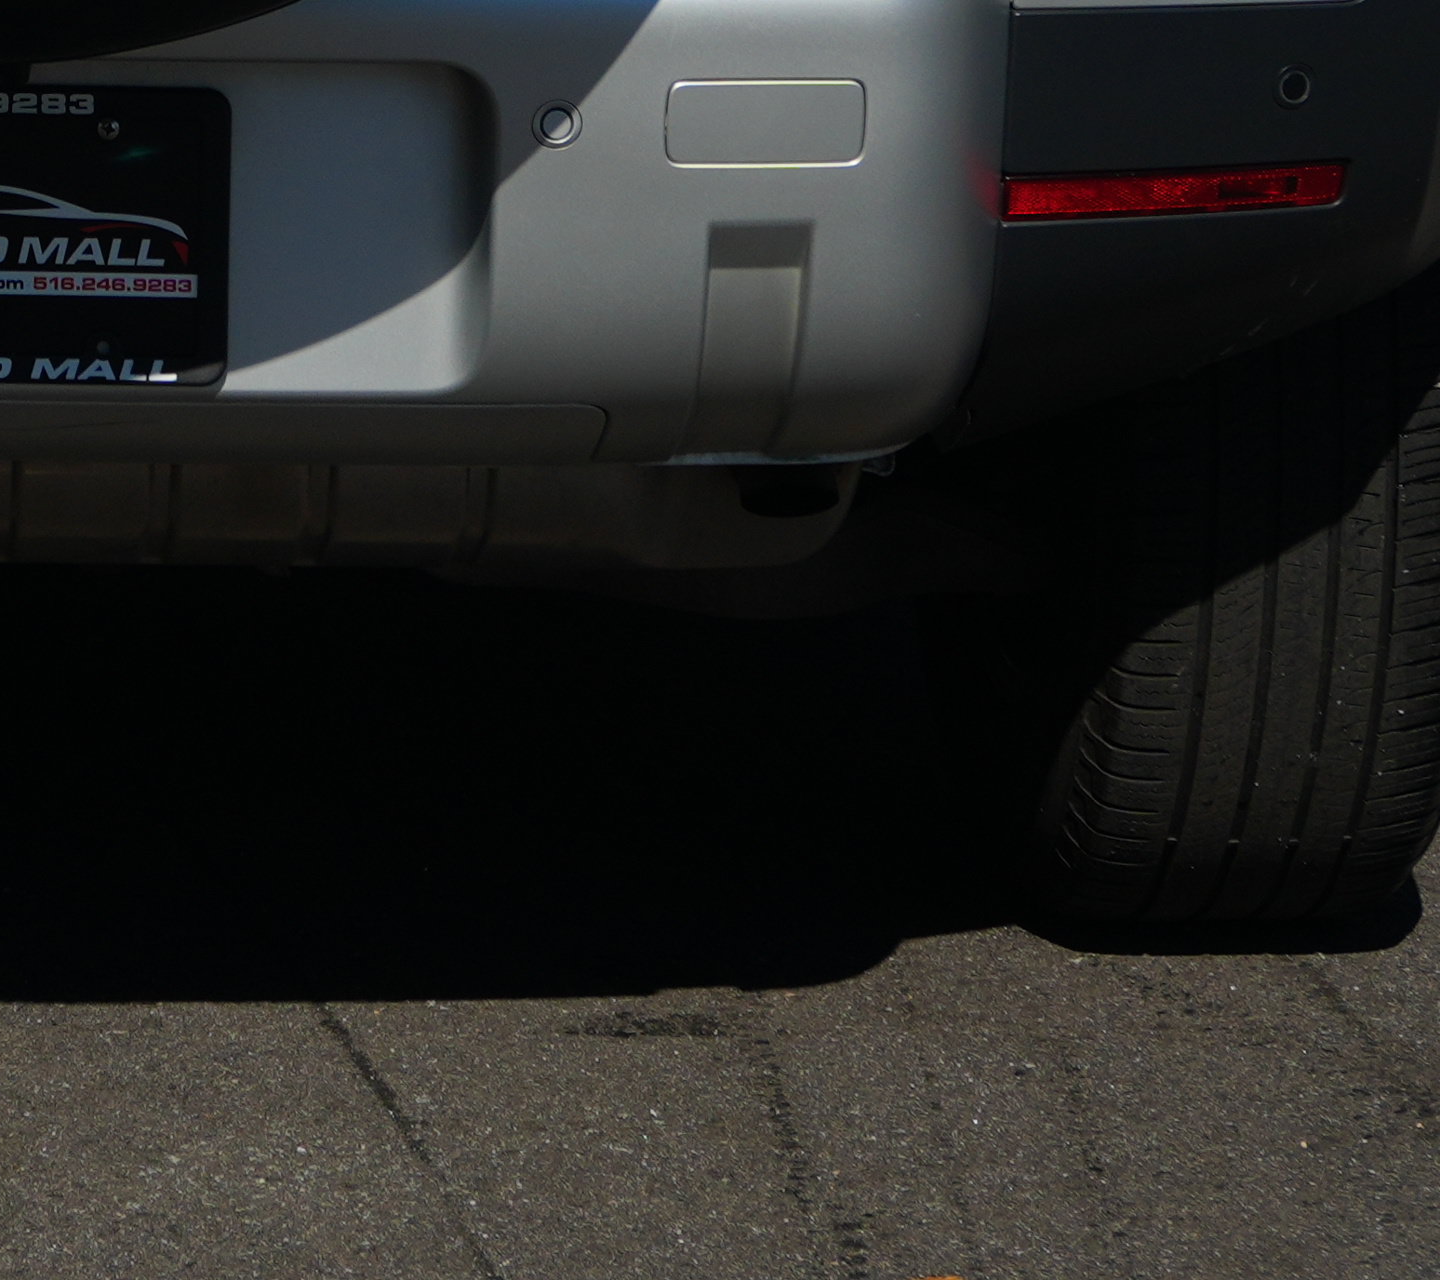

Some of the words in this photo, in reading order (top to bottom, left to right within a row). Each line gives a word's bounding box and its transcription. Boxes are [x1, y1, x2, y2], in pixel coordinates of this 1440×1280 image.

[17, 235, 166, 268] MALL
[32, 275, 193, 294] 516.246.9283
[30, 356, 178, 383] MALL
